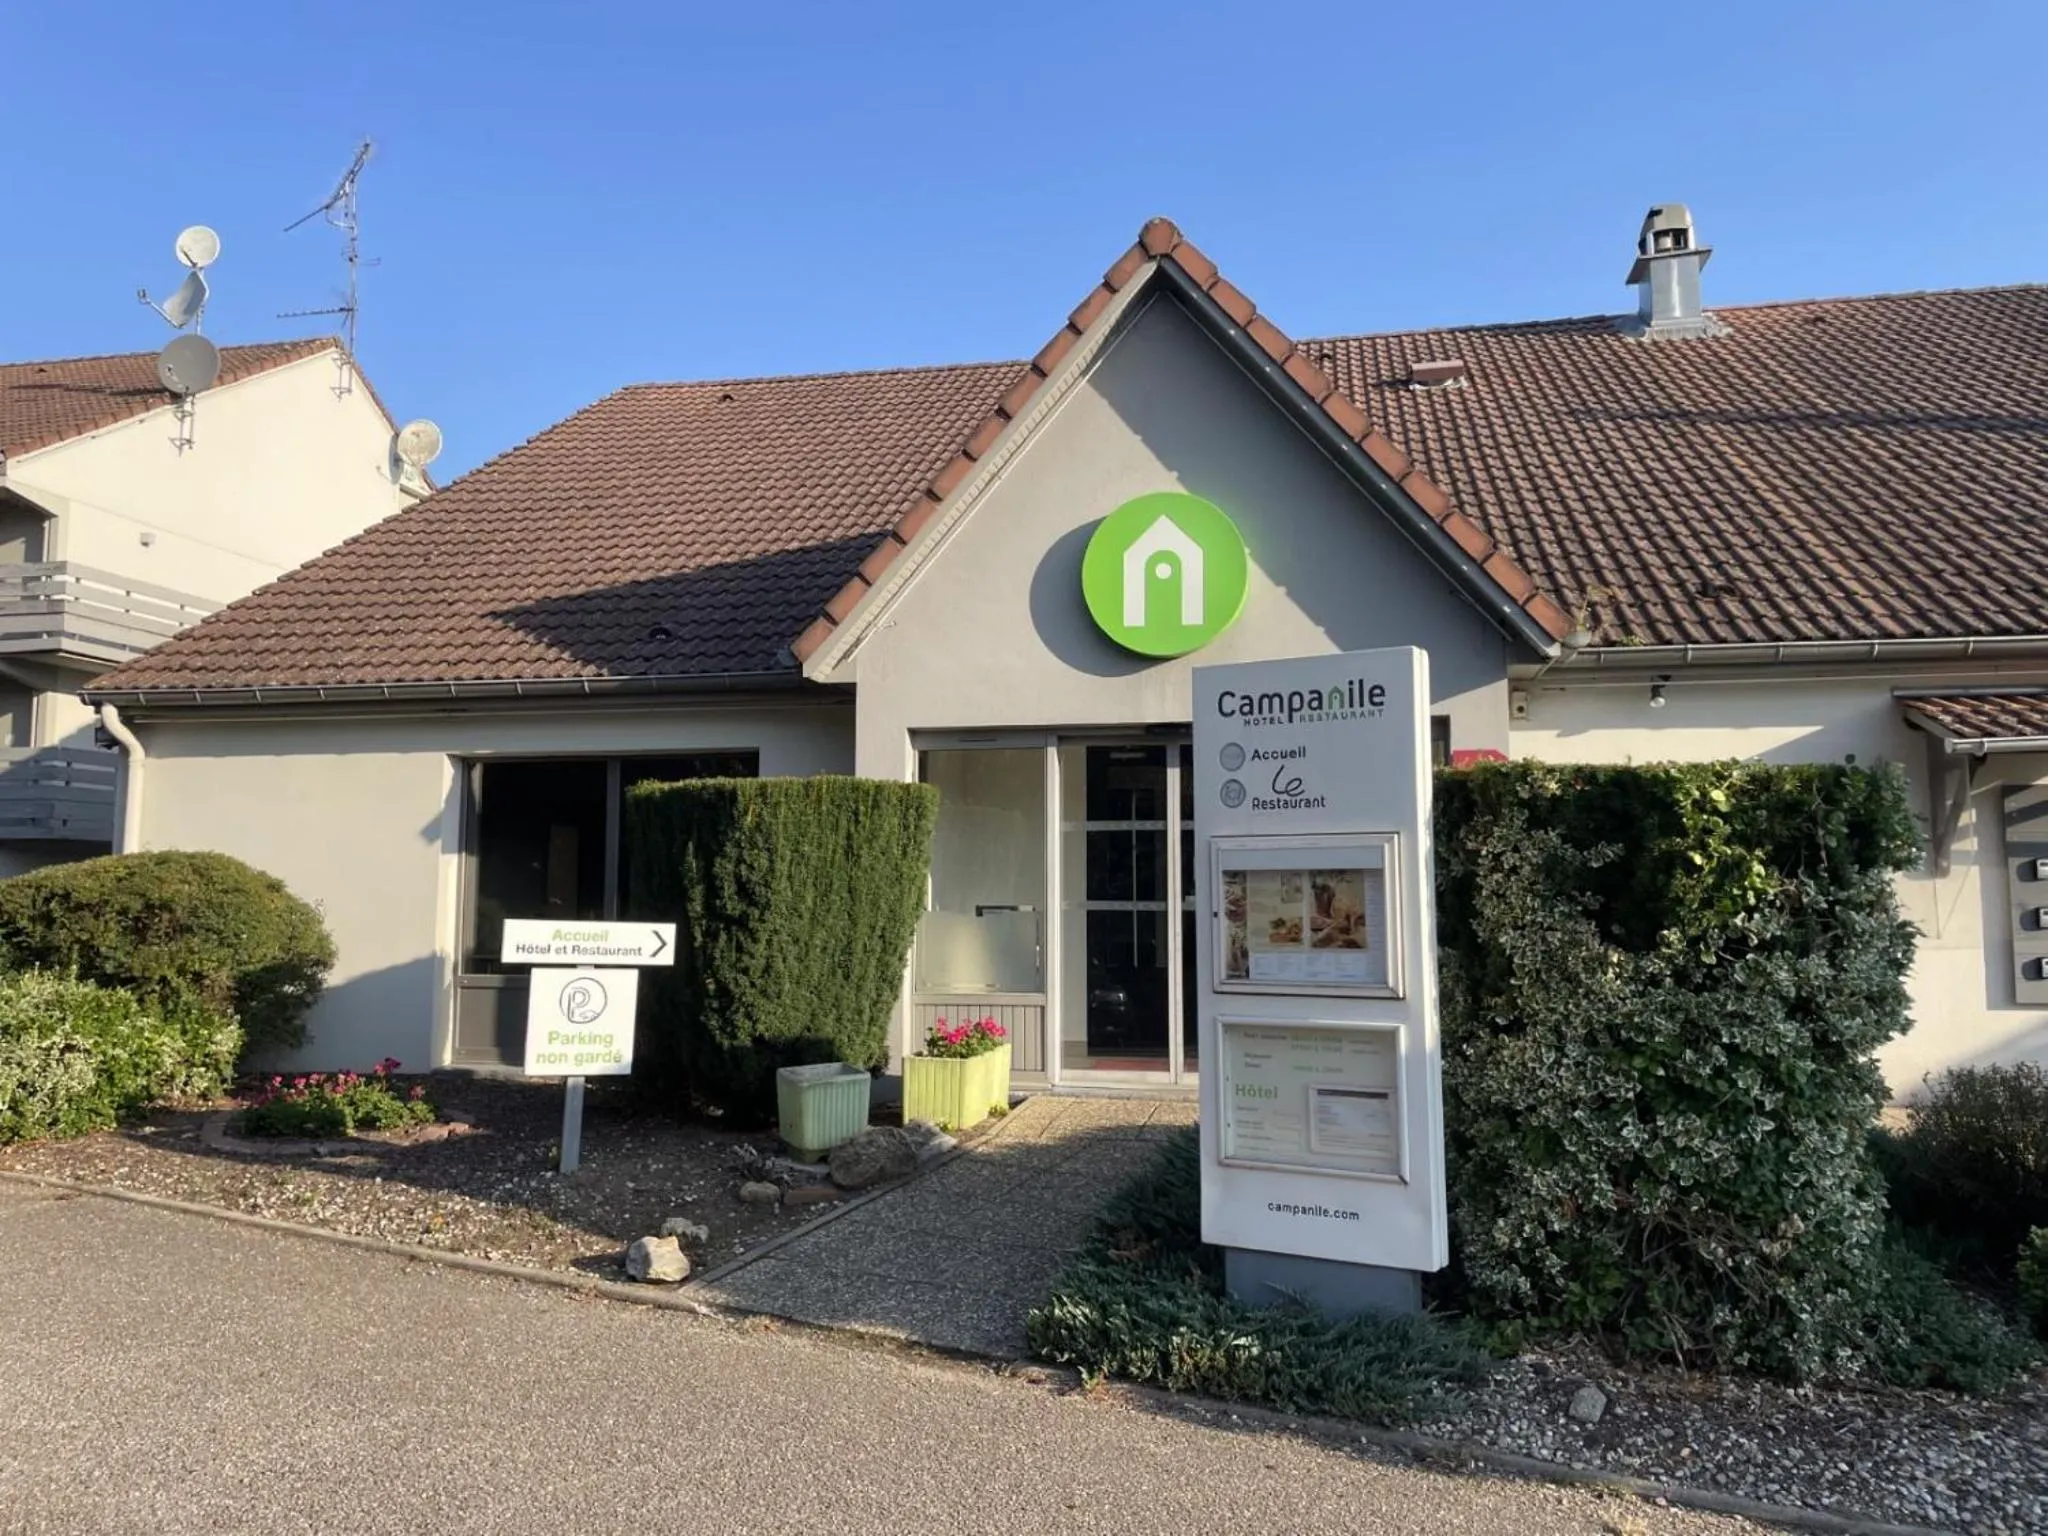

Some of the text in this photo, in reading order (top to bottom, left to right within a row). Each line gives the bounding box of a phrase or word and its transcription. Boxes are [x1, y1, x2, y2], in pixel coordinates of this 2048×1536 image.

[1217, 678, 1387, 724] Campanile
[1243, 708, 1385, 727] HOTEL RESTAURANT
[1251, 746, 1307, 762] Accueil
[1251, 794, 1327, 811] Restaurant
[552, 928, 610, 943] Accueil
[515, 943, 643, 957] Hôtel et Restaurant
[547, 1031, 614, 1048] Parking
[535, 1050, 624, 1067] non gardé
[1235, 1083, 1279, 1099] Hôtel
[1267, 1200, 1360, 1221] campanile.com
